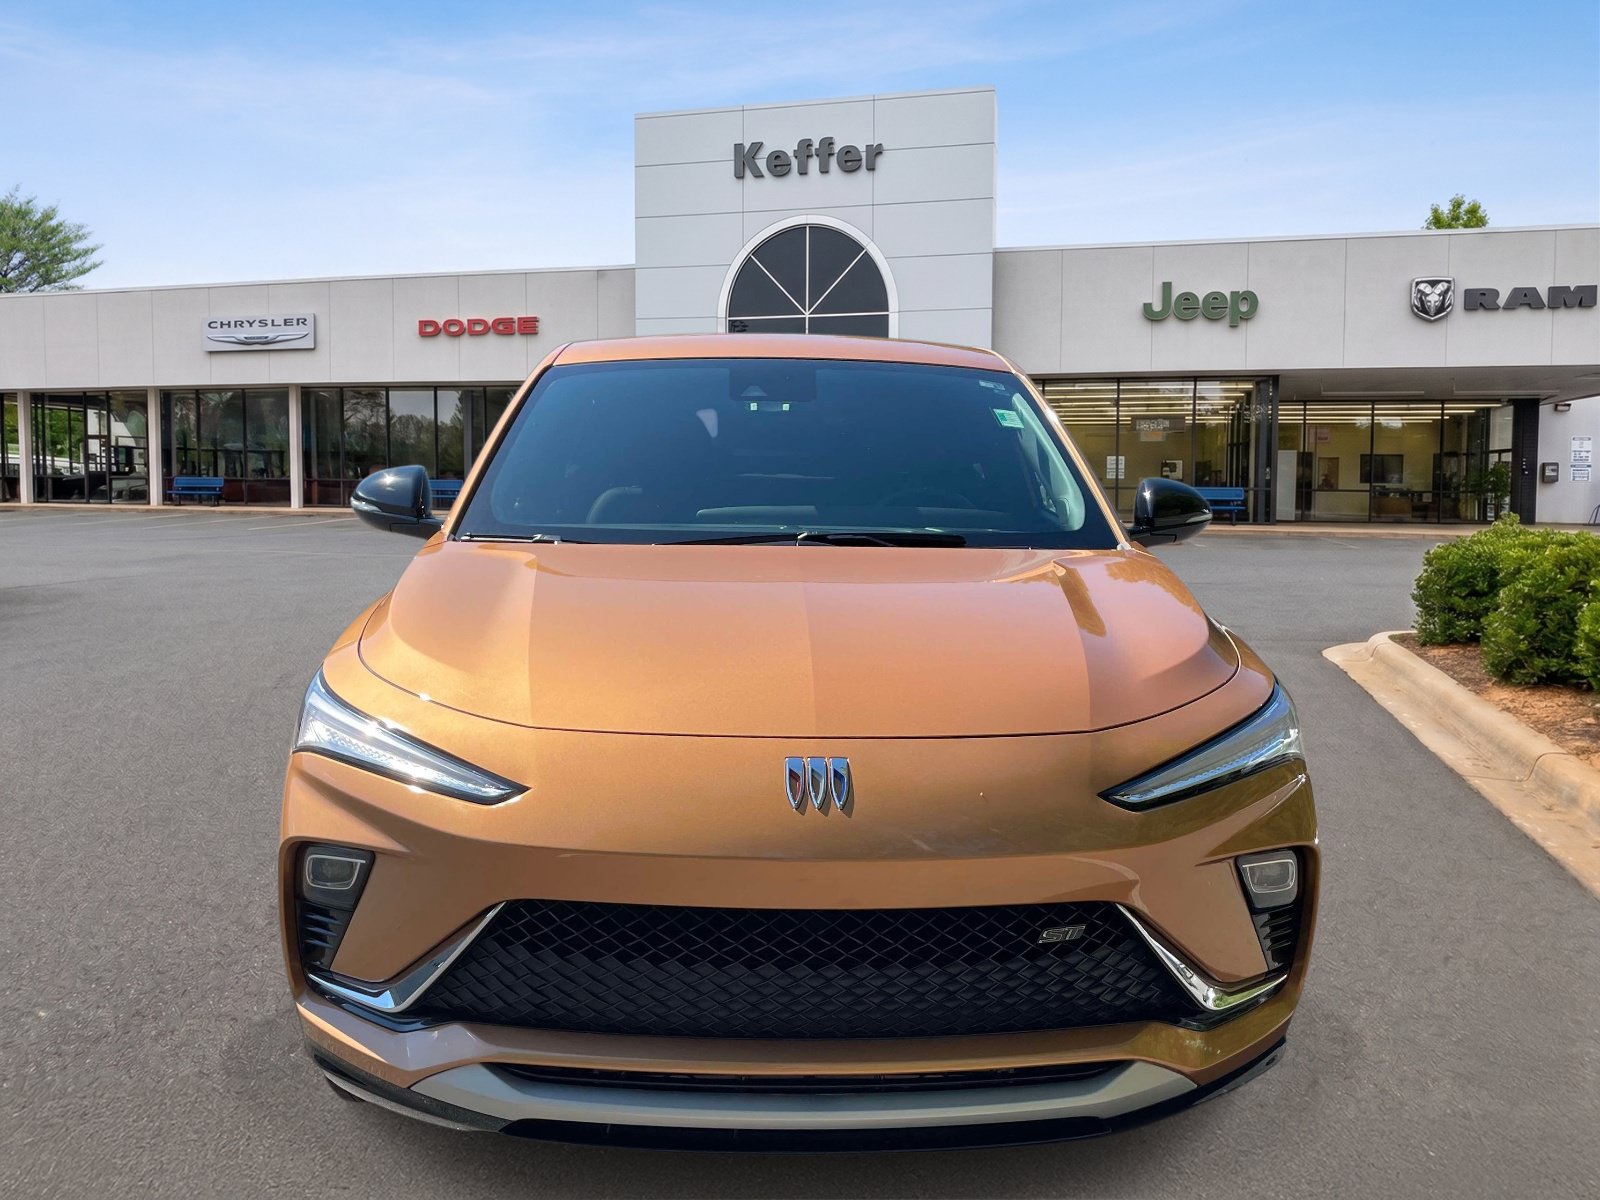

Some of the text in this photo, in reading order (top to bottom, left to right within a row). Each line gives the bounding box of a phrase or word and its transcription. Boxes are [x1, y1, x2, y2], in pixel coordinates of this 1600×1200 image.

[734, 136, 884, 180] Keffer
[1143, 281, 1260, 328] Jeep
[1464, 285, 1598, 311] RAM
[207, 316, 308, 329] CHRYSLER
[418, 316, 540, 337] DODGE
